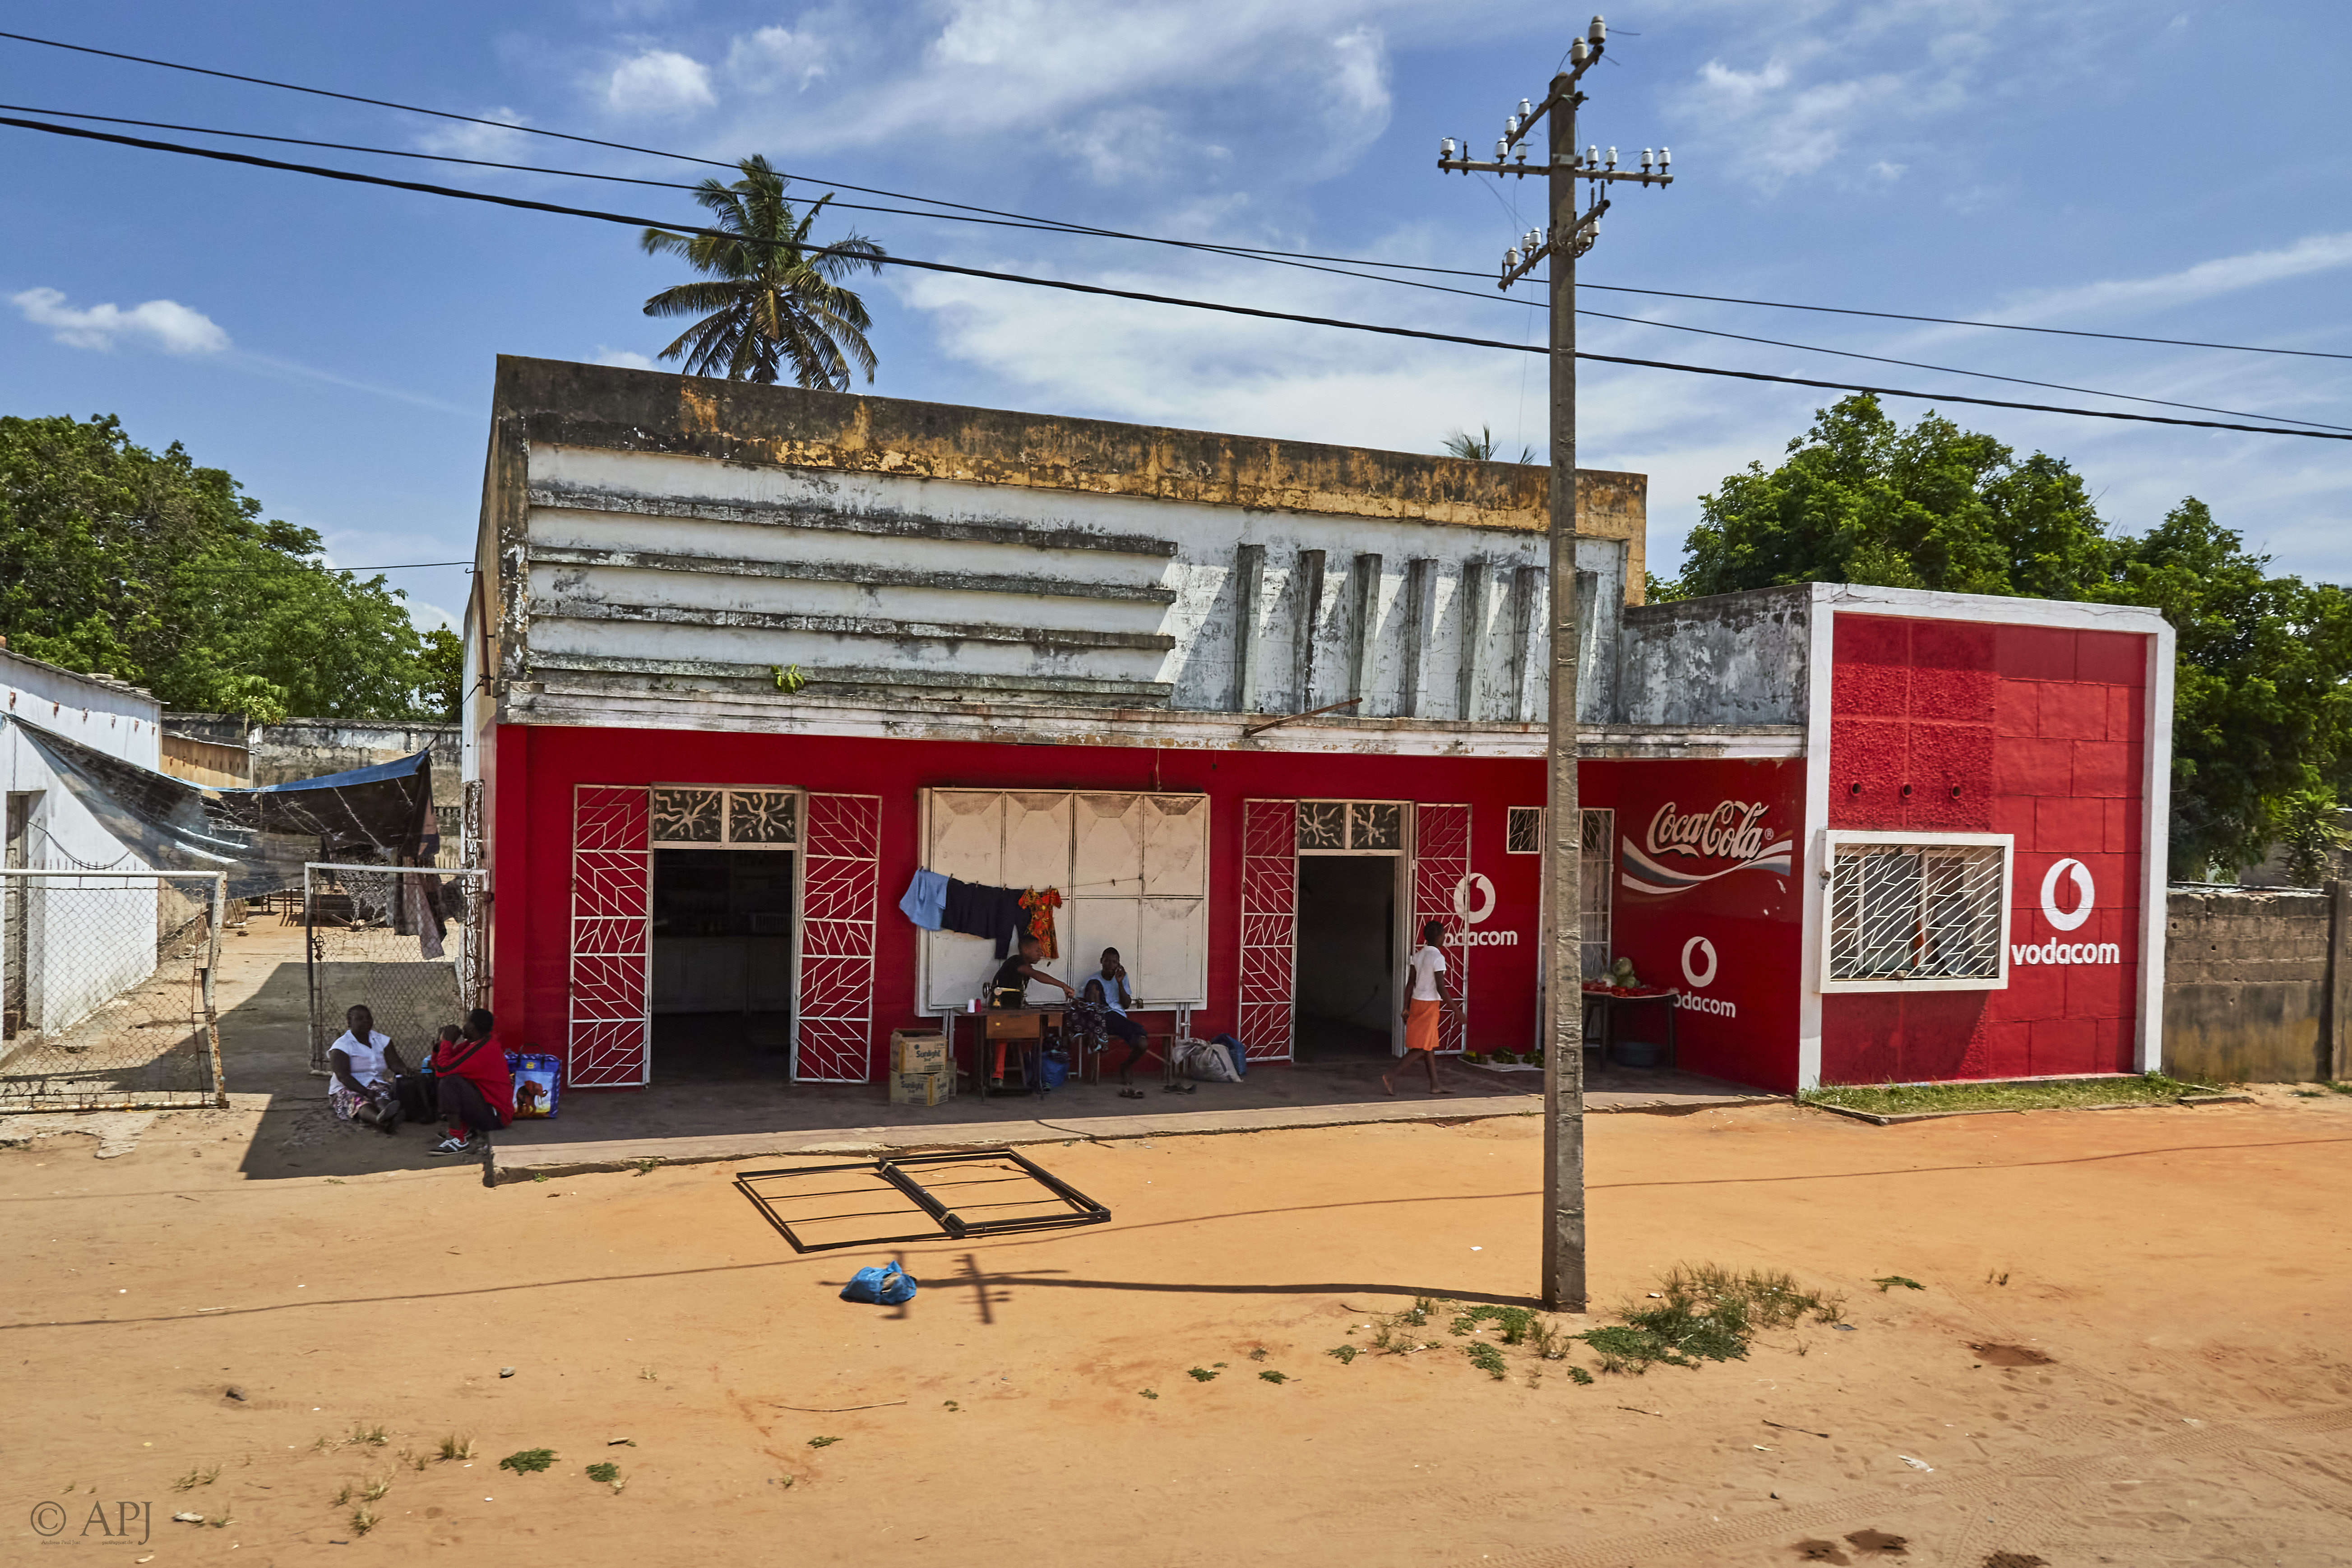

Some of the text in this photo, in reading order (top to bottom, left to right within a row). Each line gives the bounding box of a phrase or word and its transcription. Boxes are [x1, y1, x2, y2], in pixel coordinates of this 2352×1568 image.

[1445, 928, 1518, 946] odacom
[2011, 937, 2120, 965] vodacom
[1673, 991, 1736, 1018] odacom
[916, 1050, 941, 1058] Sunlight
